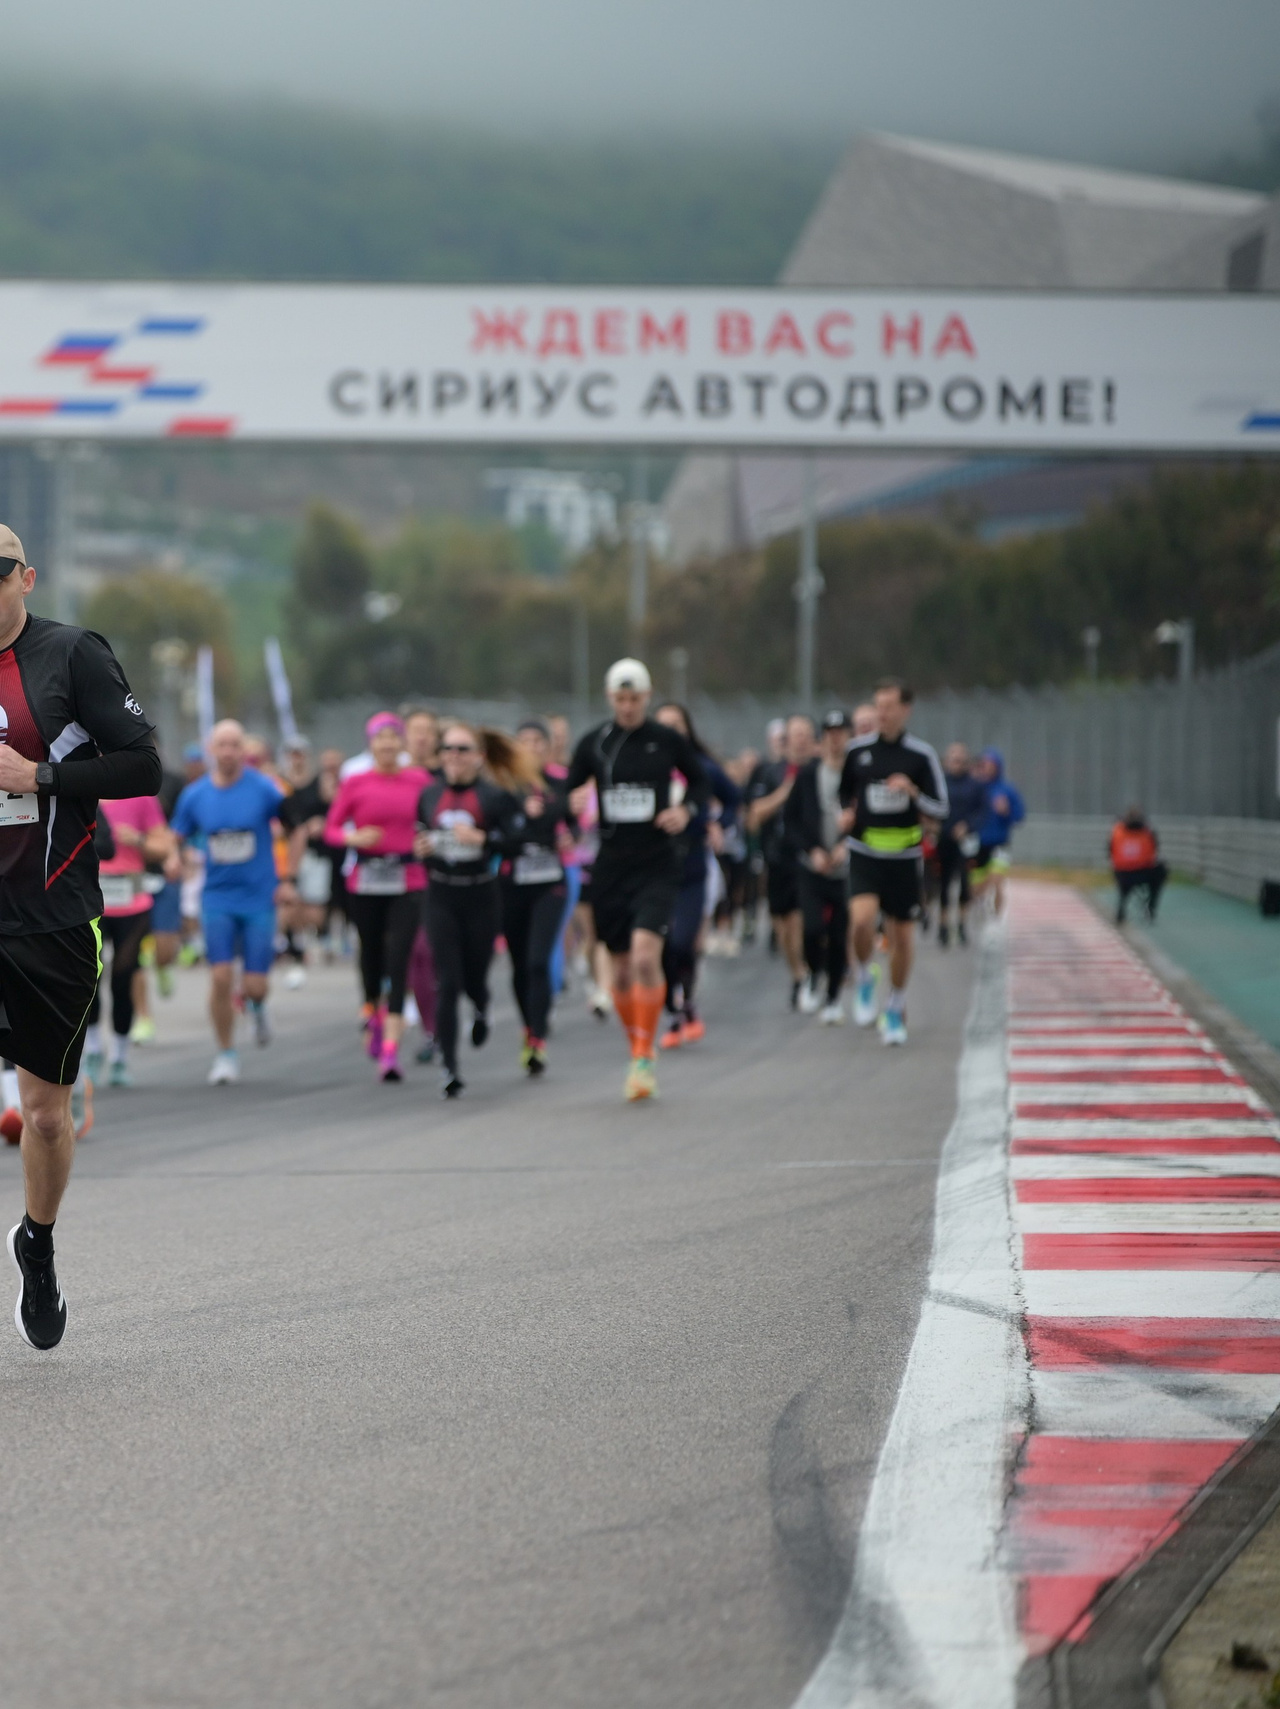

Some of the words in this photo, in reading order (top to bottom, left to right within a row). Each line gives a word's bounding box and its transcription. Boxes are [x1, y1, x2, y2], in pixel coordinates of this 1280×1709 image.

[472, 307, 688, 360] ЖДЕМ
[719, 309, 856, 358] ВАС
[881, 310, 977, 359] НА
[325, 368, 618, 418] СИРИУС
[641, 372, 1116, 427] АВТОДРОМЕ!
